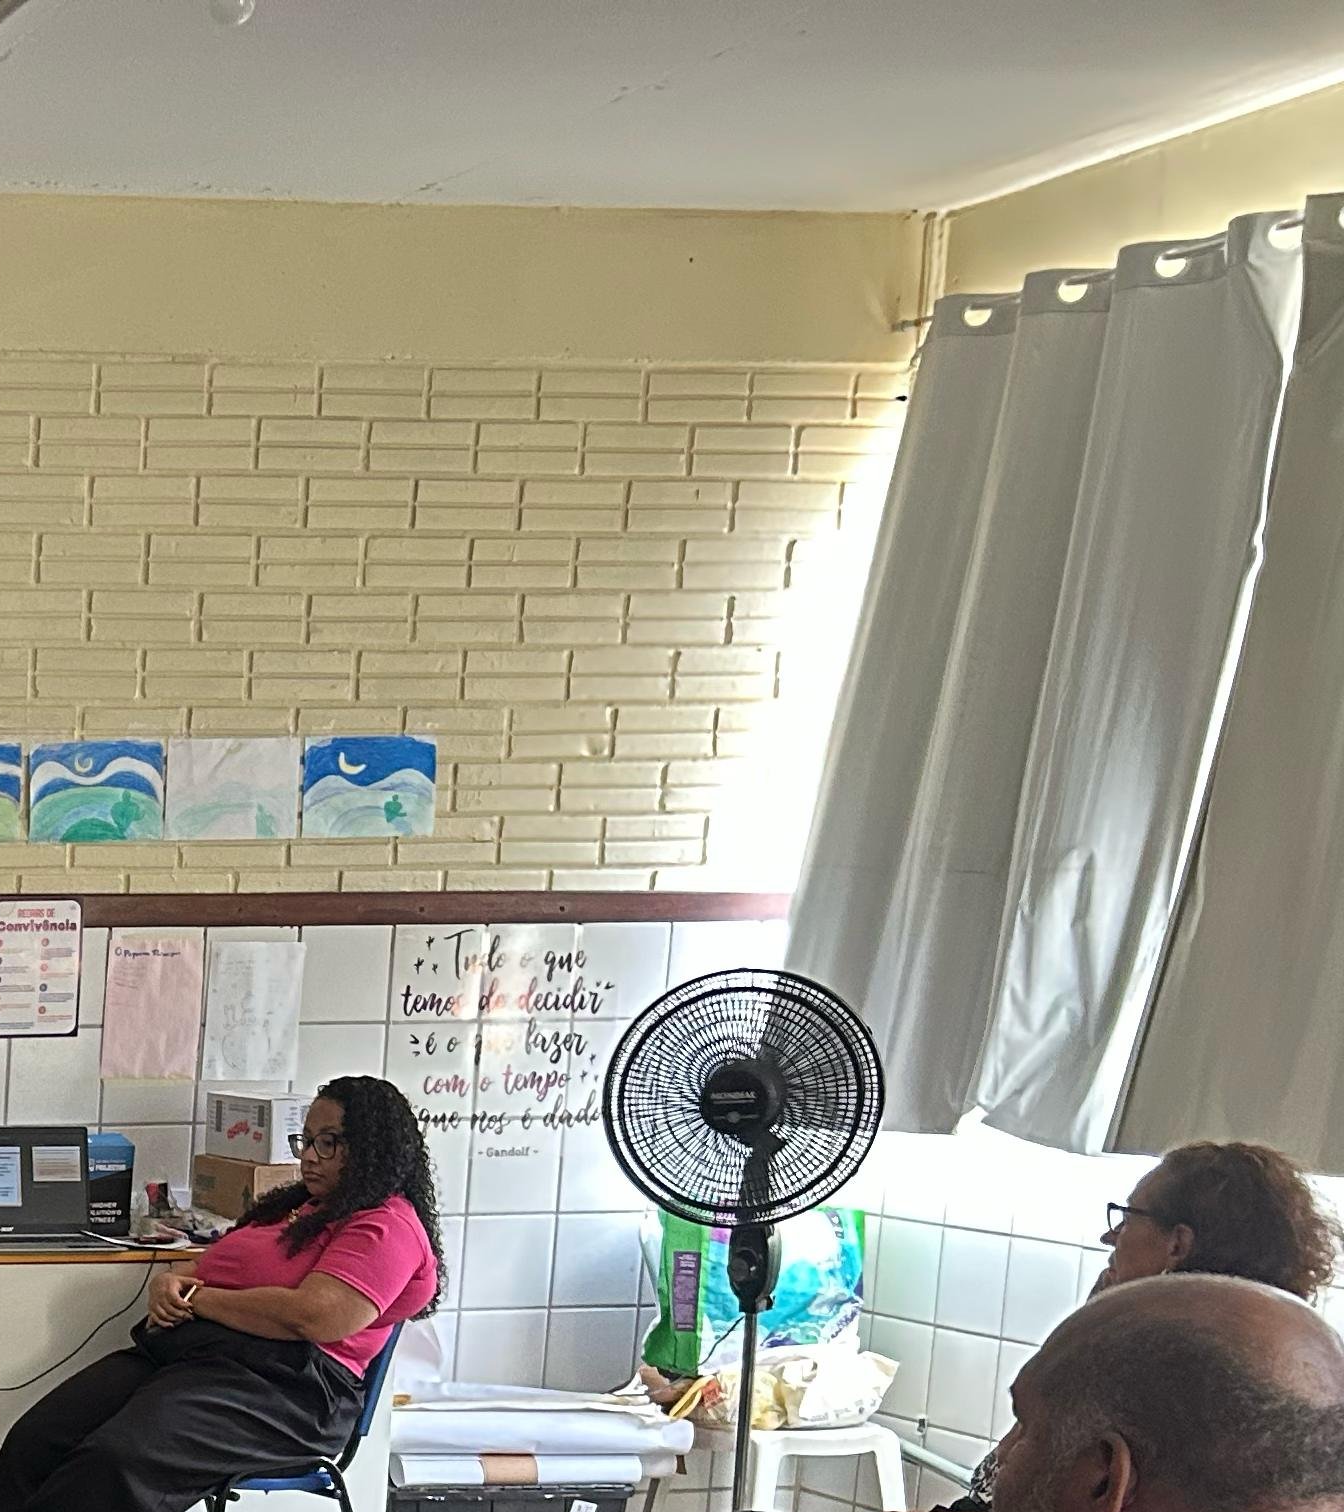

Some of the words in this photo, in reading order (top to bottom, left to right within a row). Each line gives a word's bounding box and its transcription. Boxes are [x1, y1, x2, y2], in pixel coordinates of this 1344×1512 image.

[519, 952, 532, 967] o
[544, 949, 587, 982] que
[519, 976, 603, 1014] decidir
[425, 1032, 437, 1055] é
[447, 1036, 461, 1053] o
[525, 1017, 588, 1064] fazer
[423, 1074, 470, 1097] com
[480, 1076, 493, 1092] o
[502, 1064, 570, 1102] tempo
[418, 1107, 461, 1139] que
[471, 1110, 509, 1135] nos
[521, 1107, 533, 1130] é
